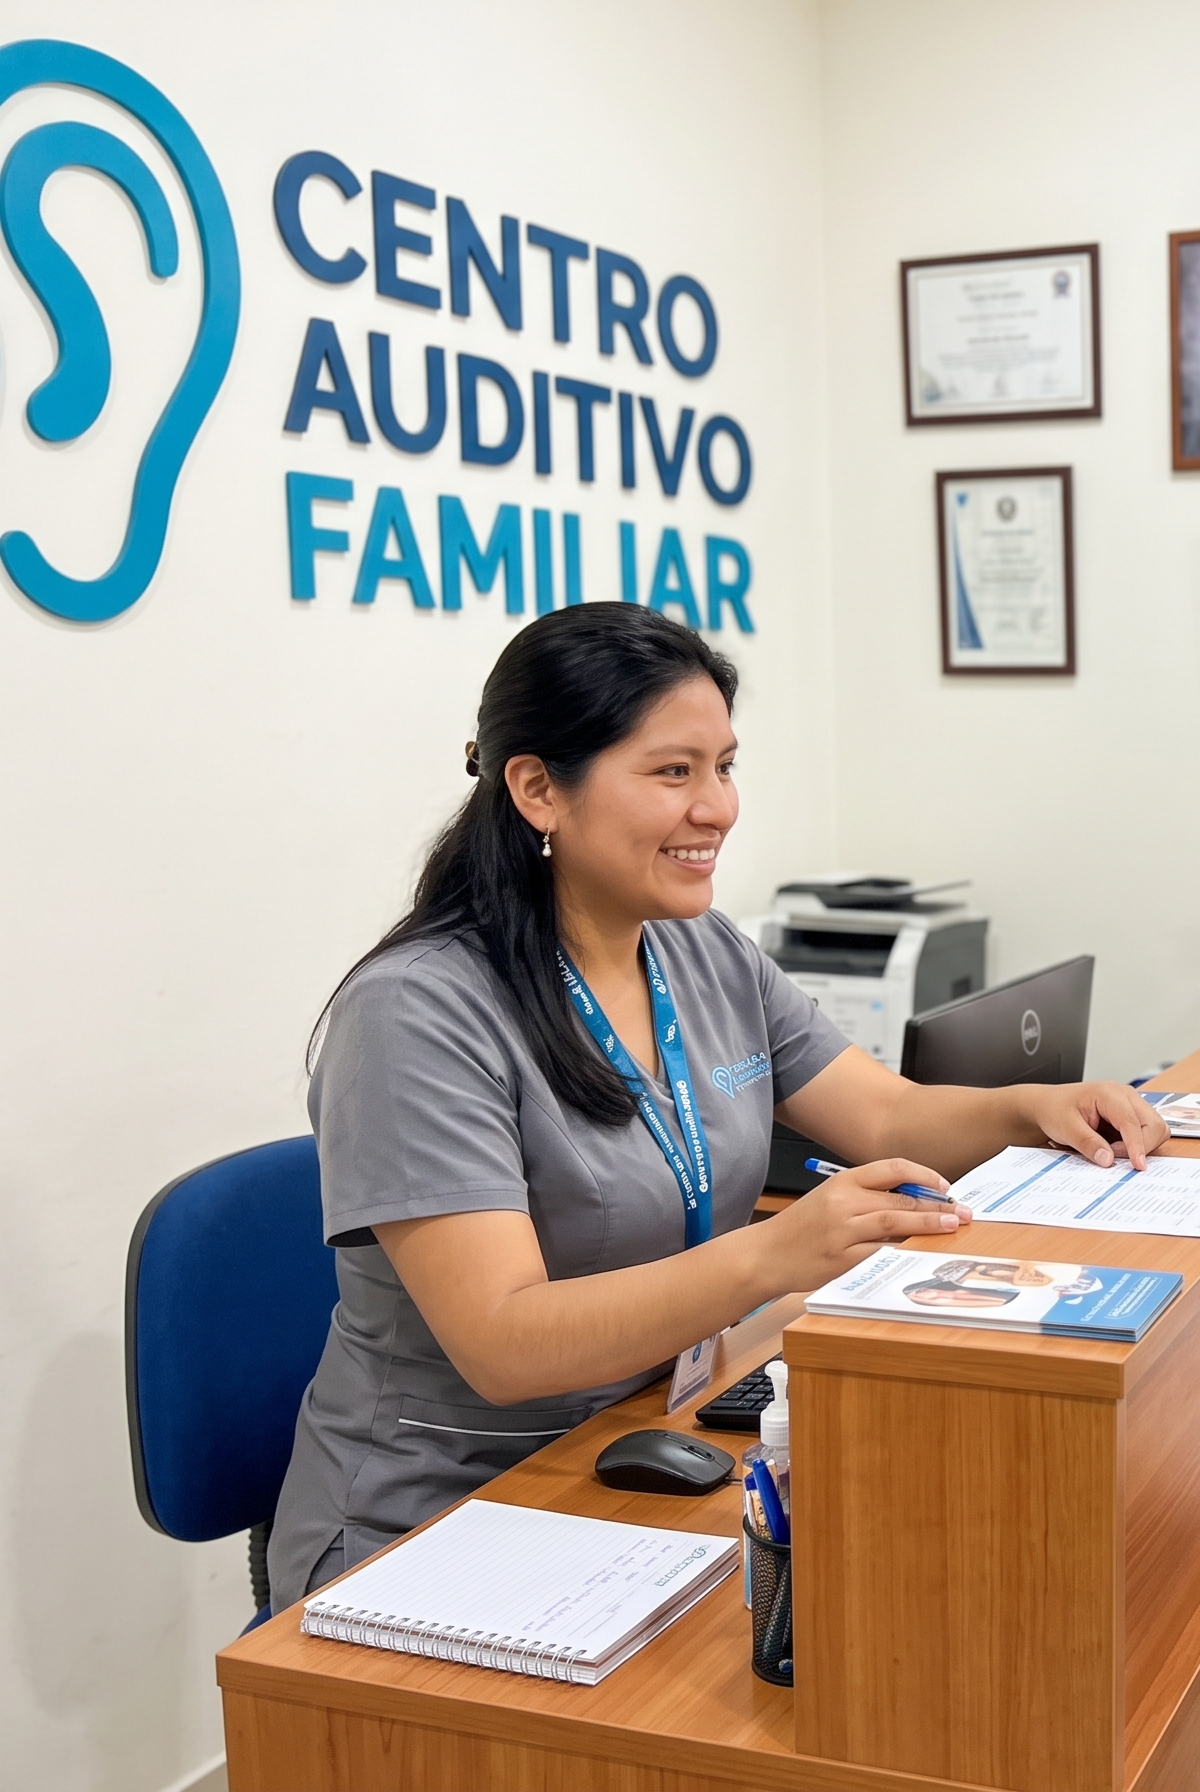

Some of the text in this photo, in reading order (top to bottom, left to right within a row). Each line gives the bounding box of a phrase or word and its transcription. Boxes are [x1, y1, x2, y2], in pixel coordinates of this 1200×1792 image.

[273, 150, 719, 379] CENTRO
[283, 317, 752, 506] AUDITIVO
[286, 471, 755, 634] FAMILIAR
